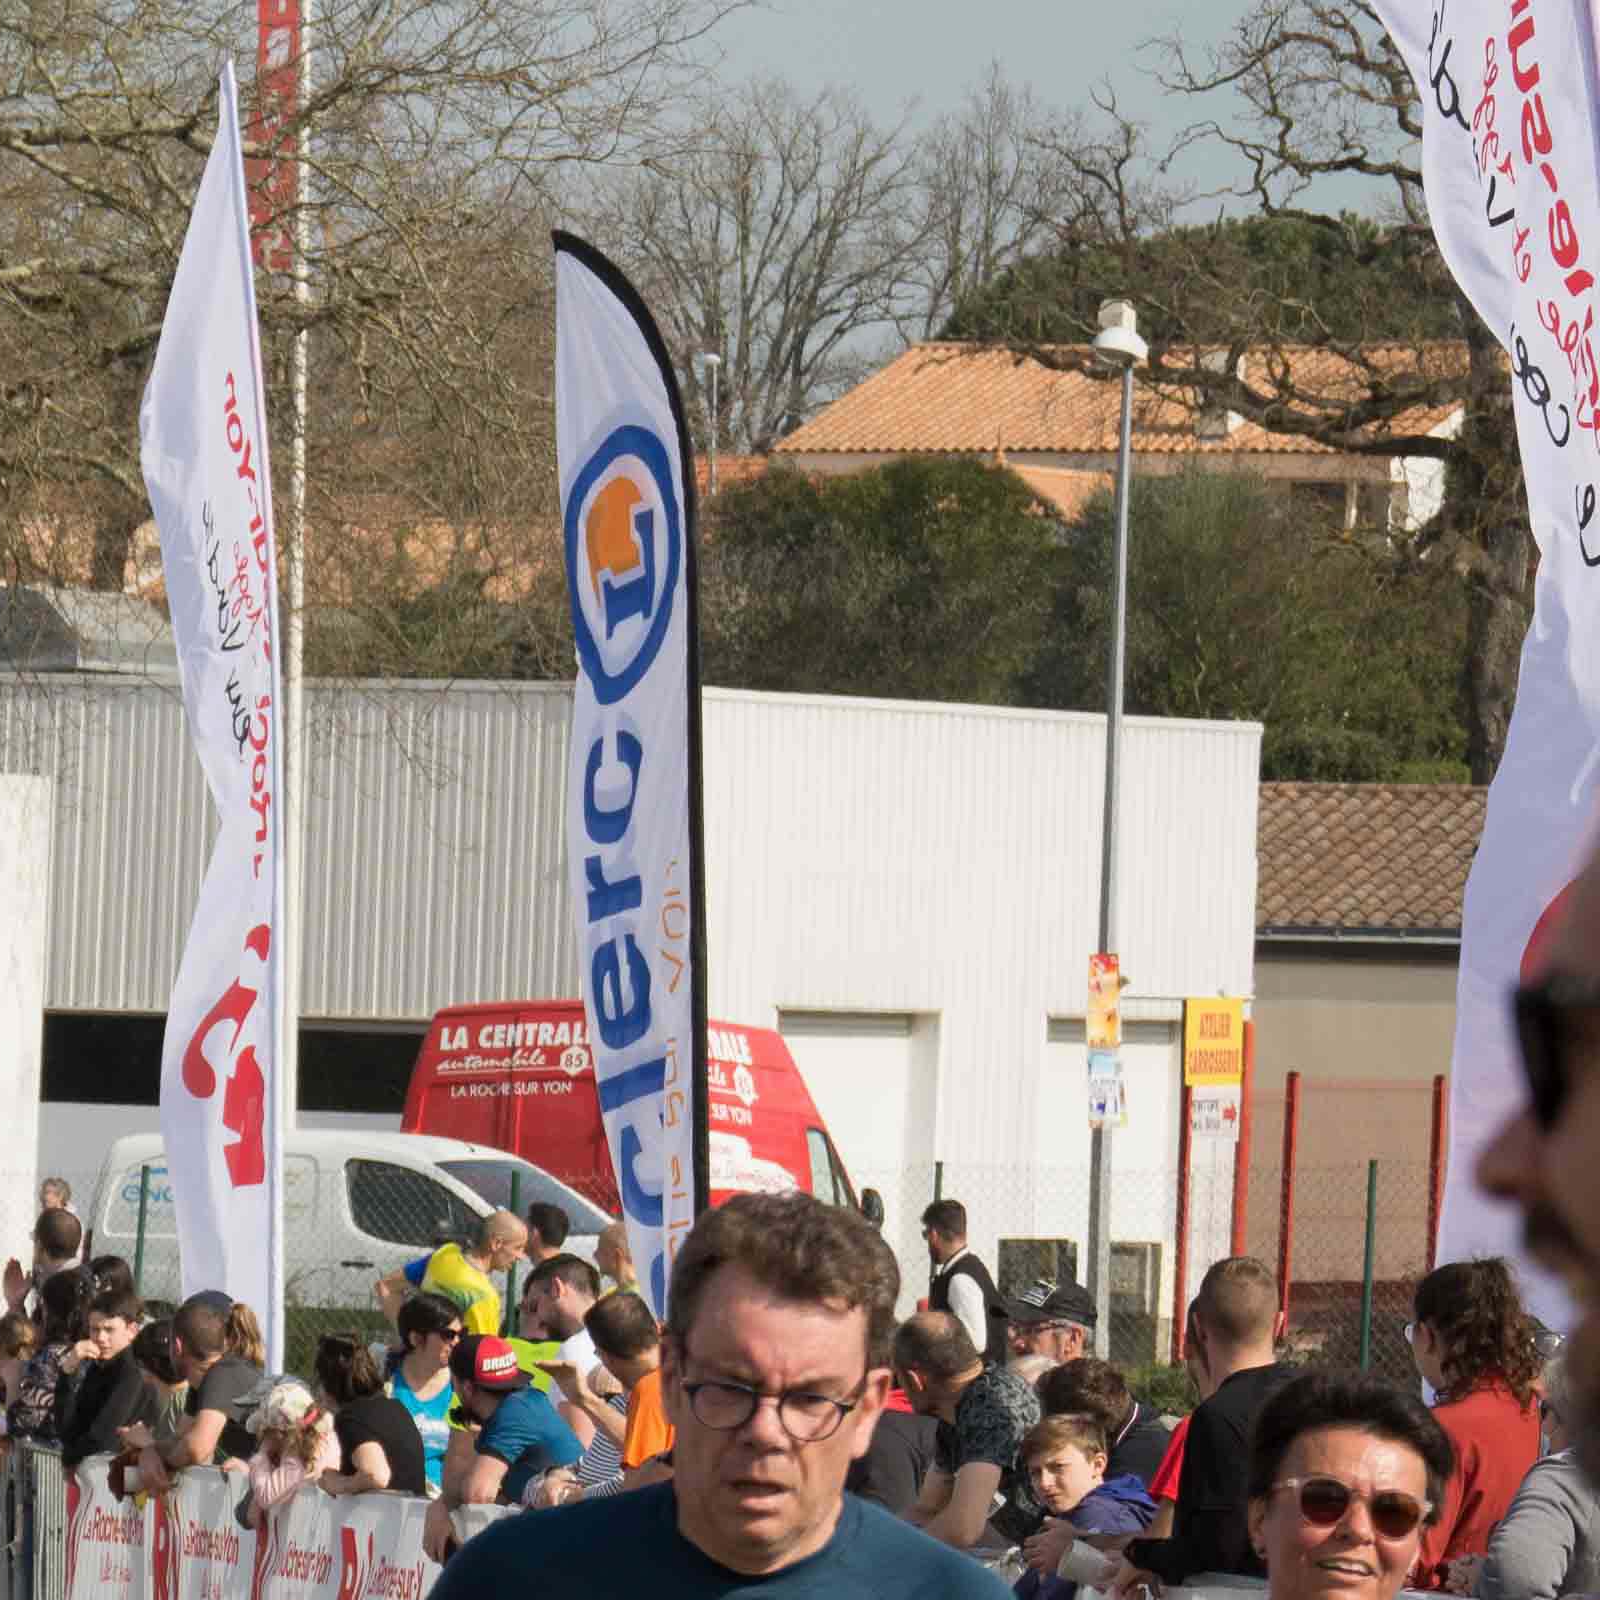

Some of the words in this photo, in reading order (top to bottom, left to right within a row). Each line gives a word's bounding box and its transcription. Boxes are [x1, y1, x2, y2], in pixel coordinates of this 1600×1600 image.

[440, 1026, 469, 1051] LA
[451, 1085, 468, 1098] LA
[470, 1083, 512, 1098] ROCHE
[514, 1082, 539, 1097] SUR
[542, 1081, 573, 1096] YON
